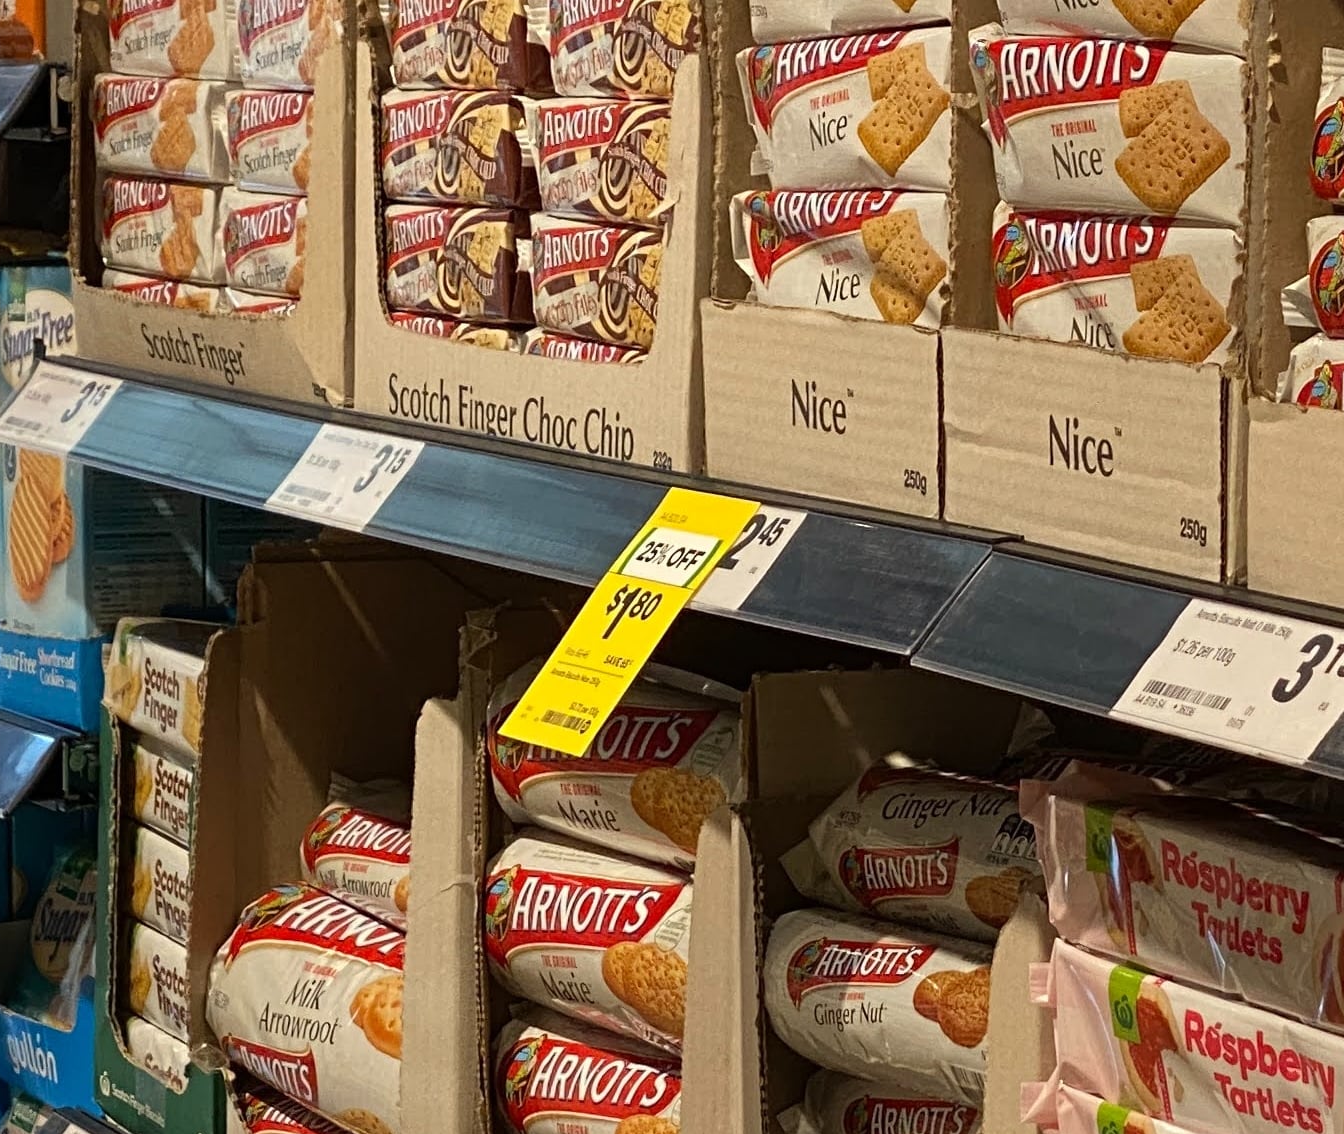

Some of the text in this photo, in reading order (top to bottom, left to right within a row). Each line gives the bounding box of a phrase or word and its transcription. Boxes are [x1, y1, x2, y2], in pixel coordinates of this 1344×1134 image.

[809, 111, 847, 151] Nice
[1065, 119, 1097, 135] ORIGINAL
[244, 146, 298, 173] Scotch Finger
[39, 311, 73, 349] Free
[142, 323, 192, 363] Scotch
[389, 373, 634, 461] Scotch Finger Choc Chip
[791, 379, 847, 434] Nice
[1049, 414, 1114, 477] Nice
[904, 469, 927, 496] 250g
[1180, 517, 1207, 547] 250g
[666, 547, 705, 570] OFF
[1215, 647, 1236, 666] 100g
[144, 658, 179, 700] Scotch
[144, 688, 177, 732] Finger
[558, 800, 619, 831] Marie
[882, 793, 955, 828] Ginger
[864, 851, 949, 889] ARNOTT'S
[1161, 839, 1309, 934] Raspberry
[512, 877, 661, 932] ARNOTT'S
[1191, 902, 1283, 964] Tartlets
[815, 945, 923, 975] ARNOTT'S
[285, 978, 326, 1010] Milk
[259, 1002, 341, 1045] Arrowroot
[814, 1002, 884, 1031] Ginger Nut
[8, 1031, 57, 1084] gullón
[531, 1045, 667, 1108] ARNOTT'S
[1184, 1009, 1334, 1107] Raspberry
[1214, 1073, 1324, 1134] Tartlets
